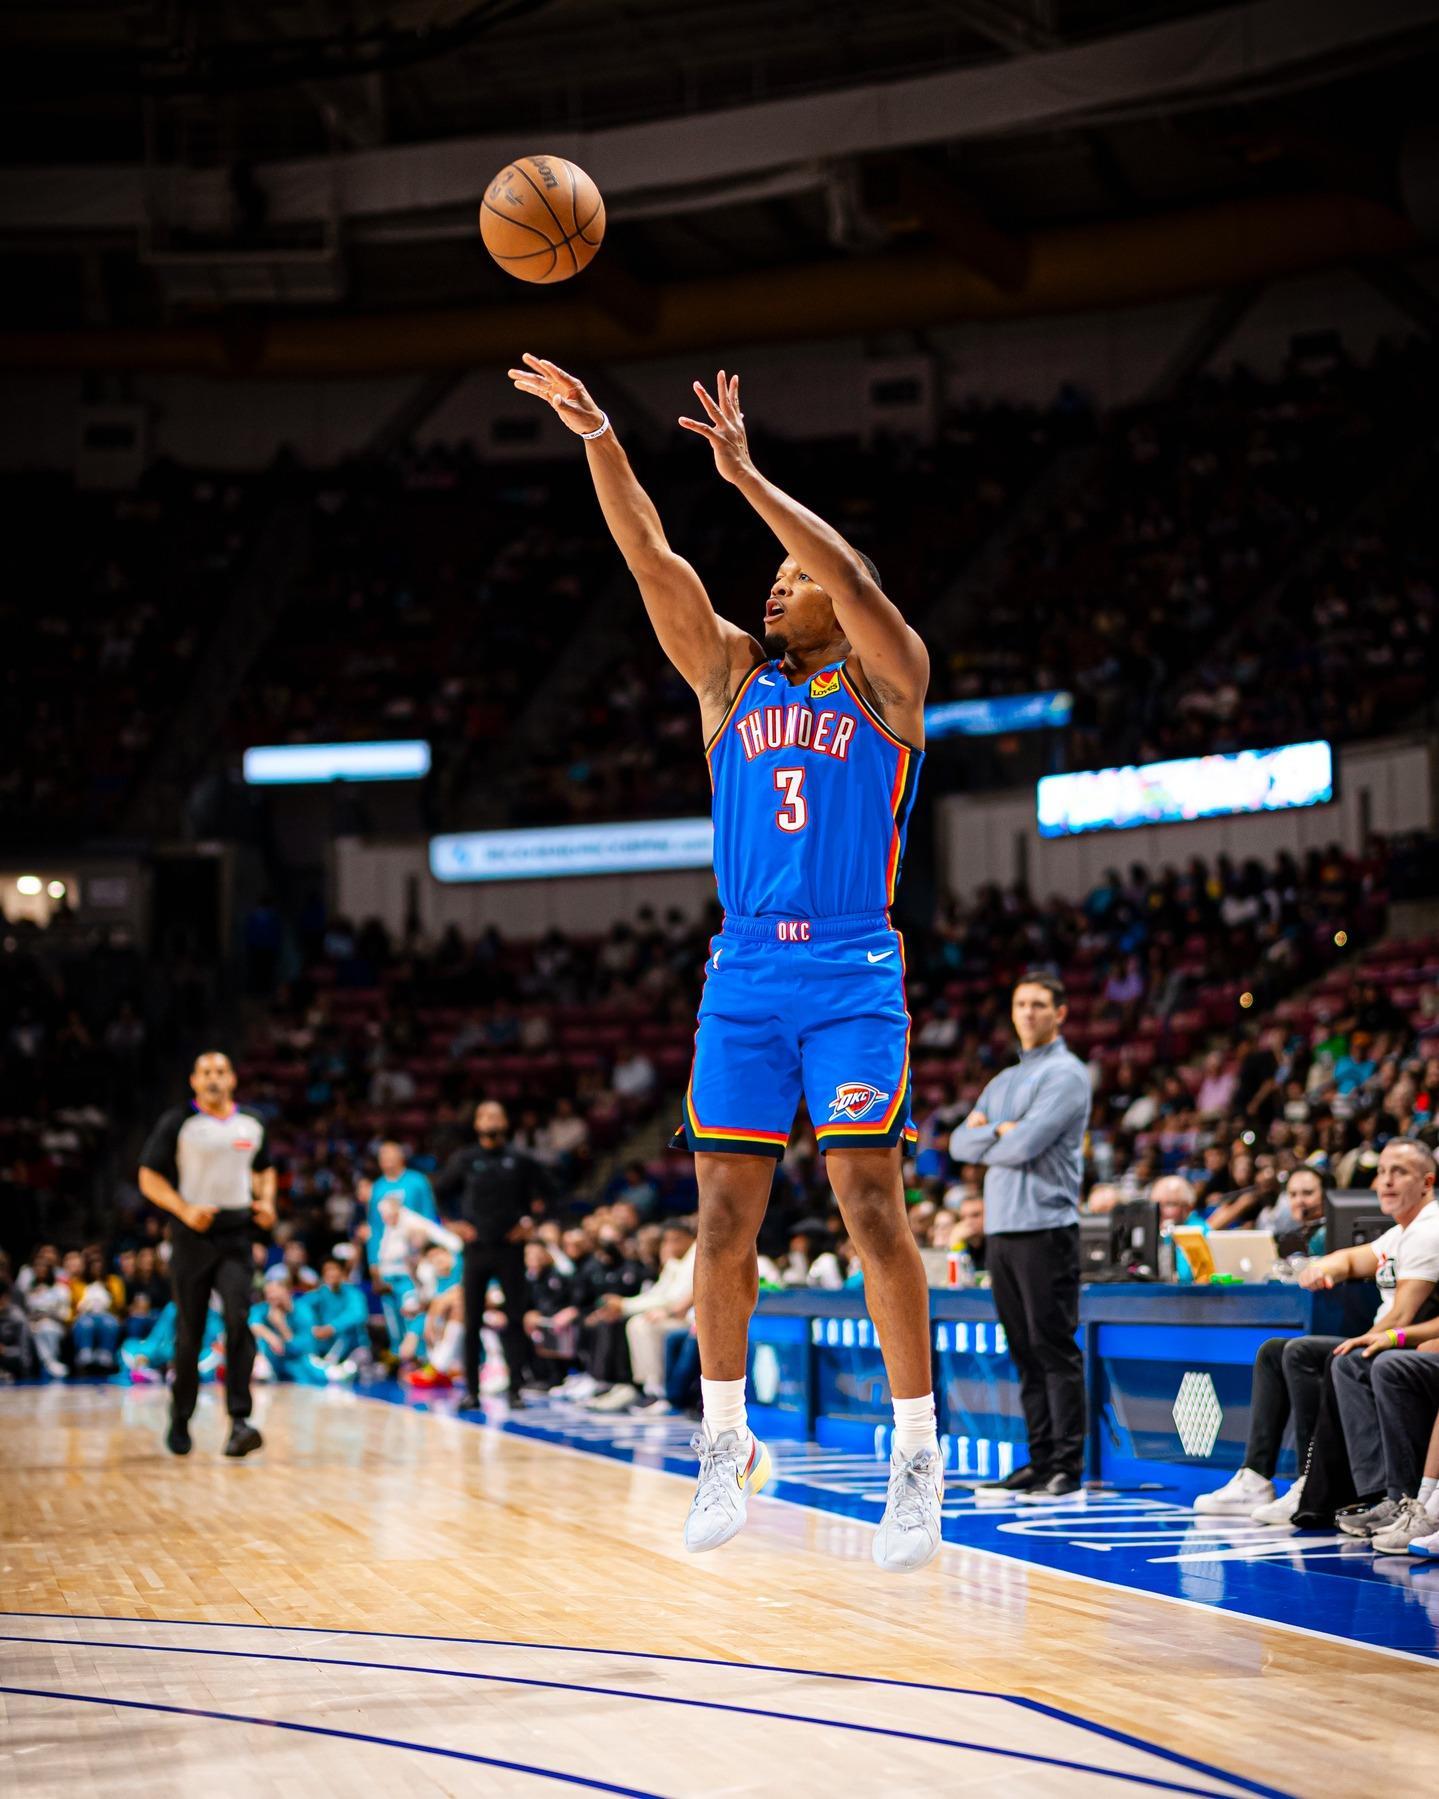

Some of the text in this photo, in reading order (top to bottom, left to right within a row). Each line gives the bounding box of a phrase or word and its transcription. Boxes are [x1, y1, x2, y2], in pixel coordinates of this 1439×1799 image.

[737, 703, 856, 762] THUNDER
[774, 768, 808, 832] 3
[776, 921, 811, 942] OKC
[838, 1091, 868, 1109] OKC
